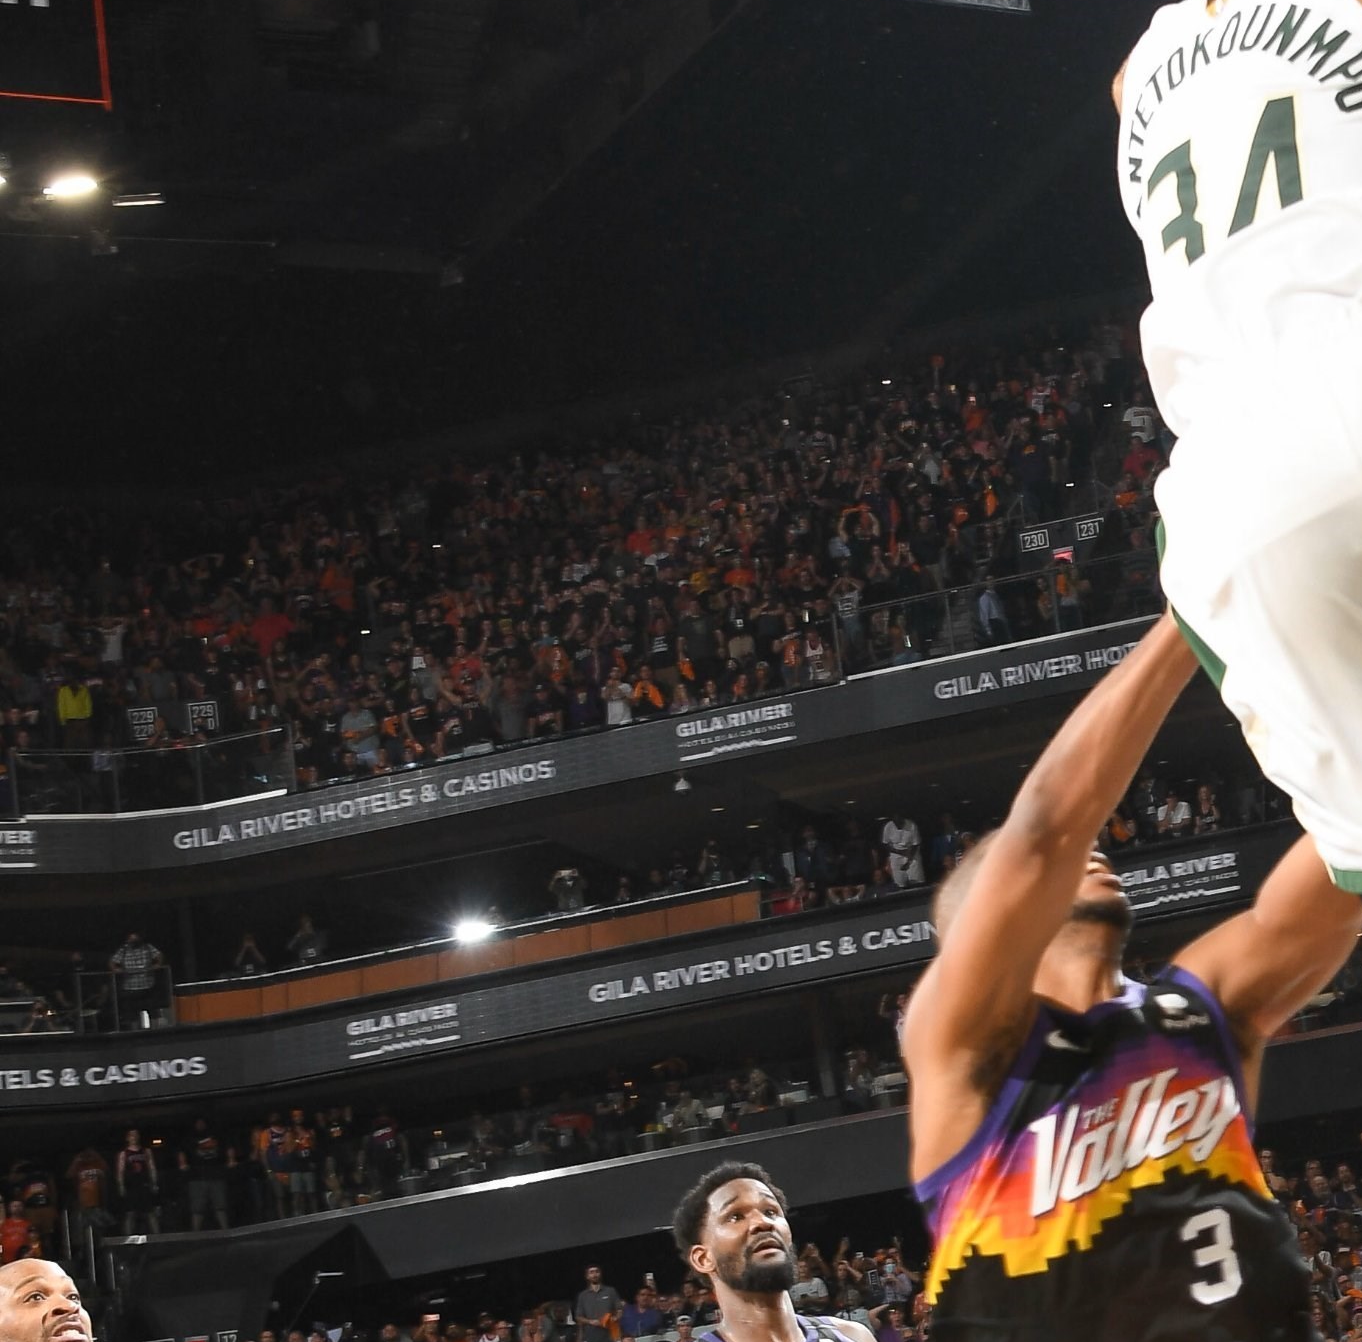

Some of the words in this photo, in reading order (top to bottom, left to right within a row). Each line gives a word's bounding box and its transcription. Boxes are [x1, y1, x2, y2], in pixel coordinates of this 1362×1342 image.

[1024, 533, 1045, 549] 230
[934, 671, 1000, 700] GILA
[1000, 655, 1083, 688] RIVER
[173, 824, 235, 850] GILA
[240, 808, 317, 839] RIVER
[319, 787, 415, 824] HOTELS
[419, 782, 437, 803] &
[443, 760, 556, 798] CASINOS
[1170, 852, 1236, 877] RIVER
[588, 976, 650, 1002] GILA
[653, 960, 731, 991] RIVER
[734, 940, 834, 976] HOTELS
[838, 936, 858, 955] &
[861, 921, 940, 951] CASIN
[346, 1017, 396, 1036] GILA
[395, 1003, 458, 1027] RIVER
[60, 1067, 80, 1087] &
[85, 1056, 208, 1087] CASINOS
[1083, 1097, 1120, 1131] THE
[1029, 1068, 1241, 1218] Valley
[1180, 1208, 1243, 1305] 3
